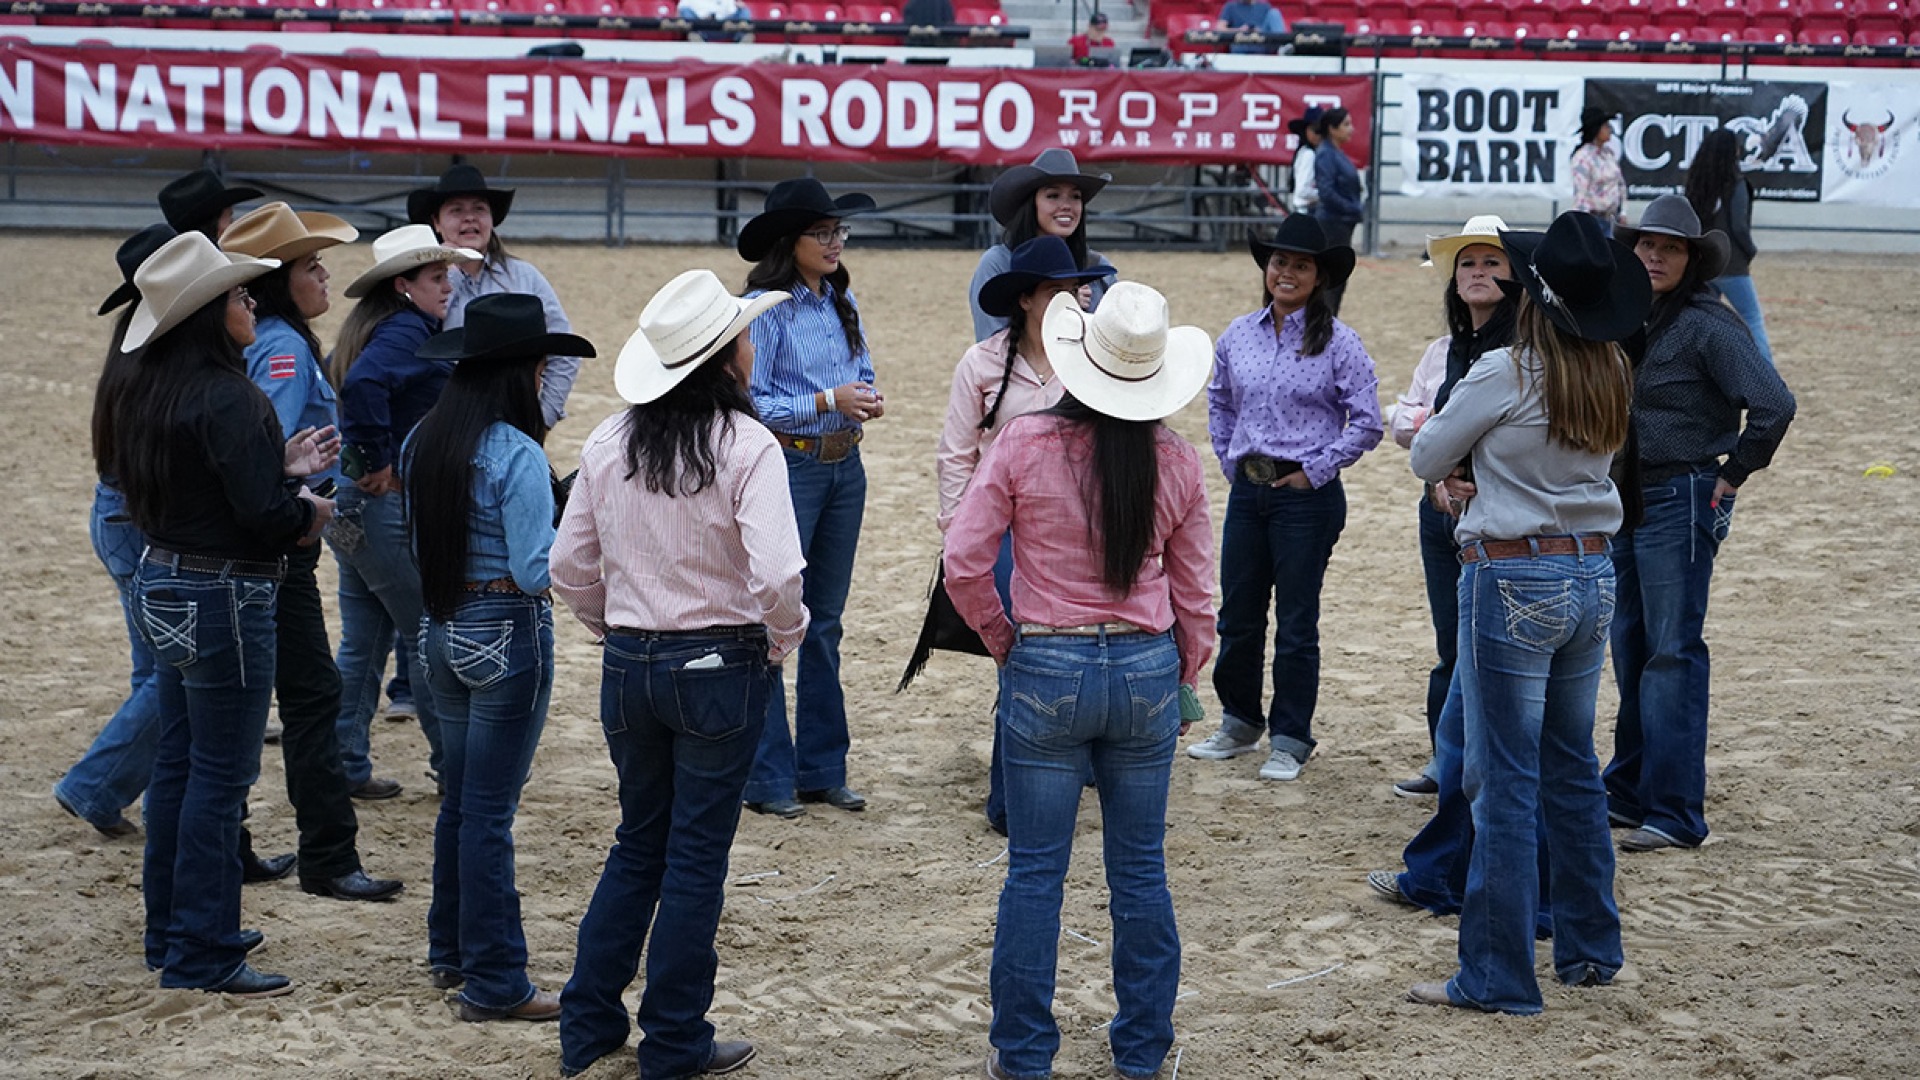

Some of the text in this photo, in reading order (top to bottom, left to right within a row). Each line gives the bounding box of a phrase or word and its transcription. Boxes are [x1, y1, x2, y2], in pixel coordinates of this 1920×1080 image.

[1682, 83, 1708, 95] Major
[64, 61, 461, 140] NATIONAL
[486, 74, 756, 146] FINALS
[781, 78, 1035, 151] RODEO
[1417, 87, 1559, 133] BOOT
[1058, 128, 1151, 148] WEAR
[1172, 131, 1236, 148] THE
[1416, 138, 1557, 184] BARN
[1628, 184, 1675, 196] California
[1759, 187, 1818, 198] Association
